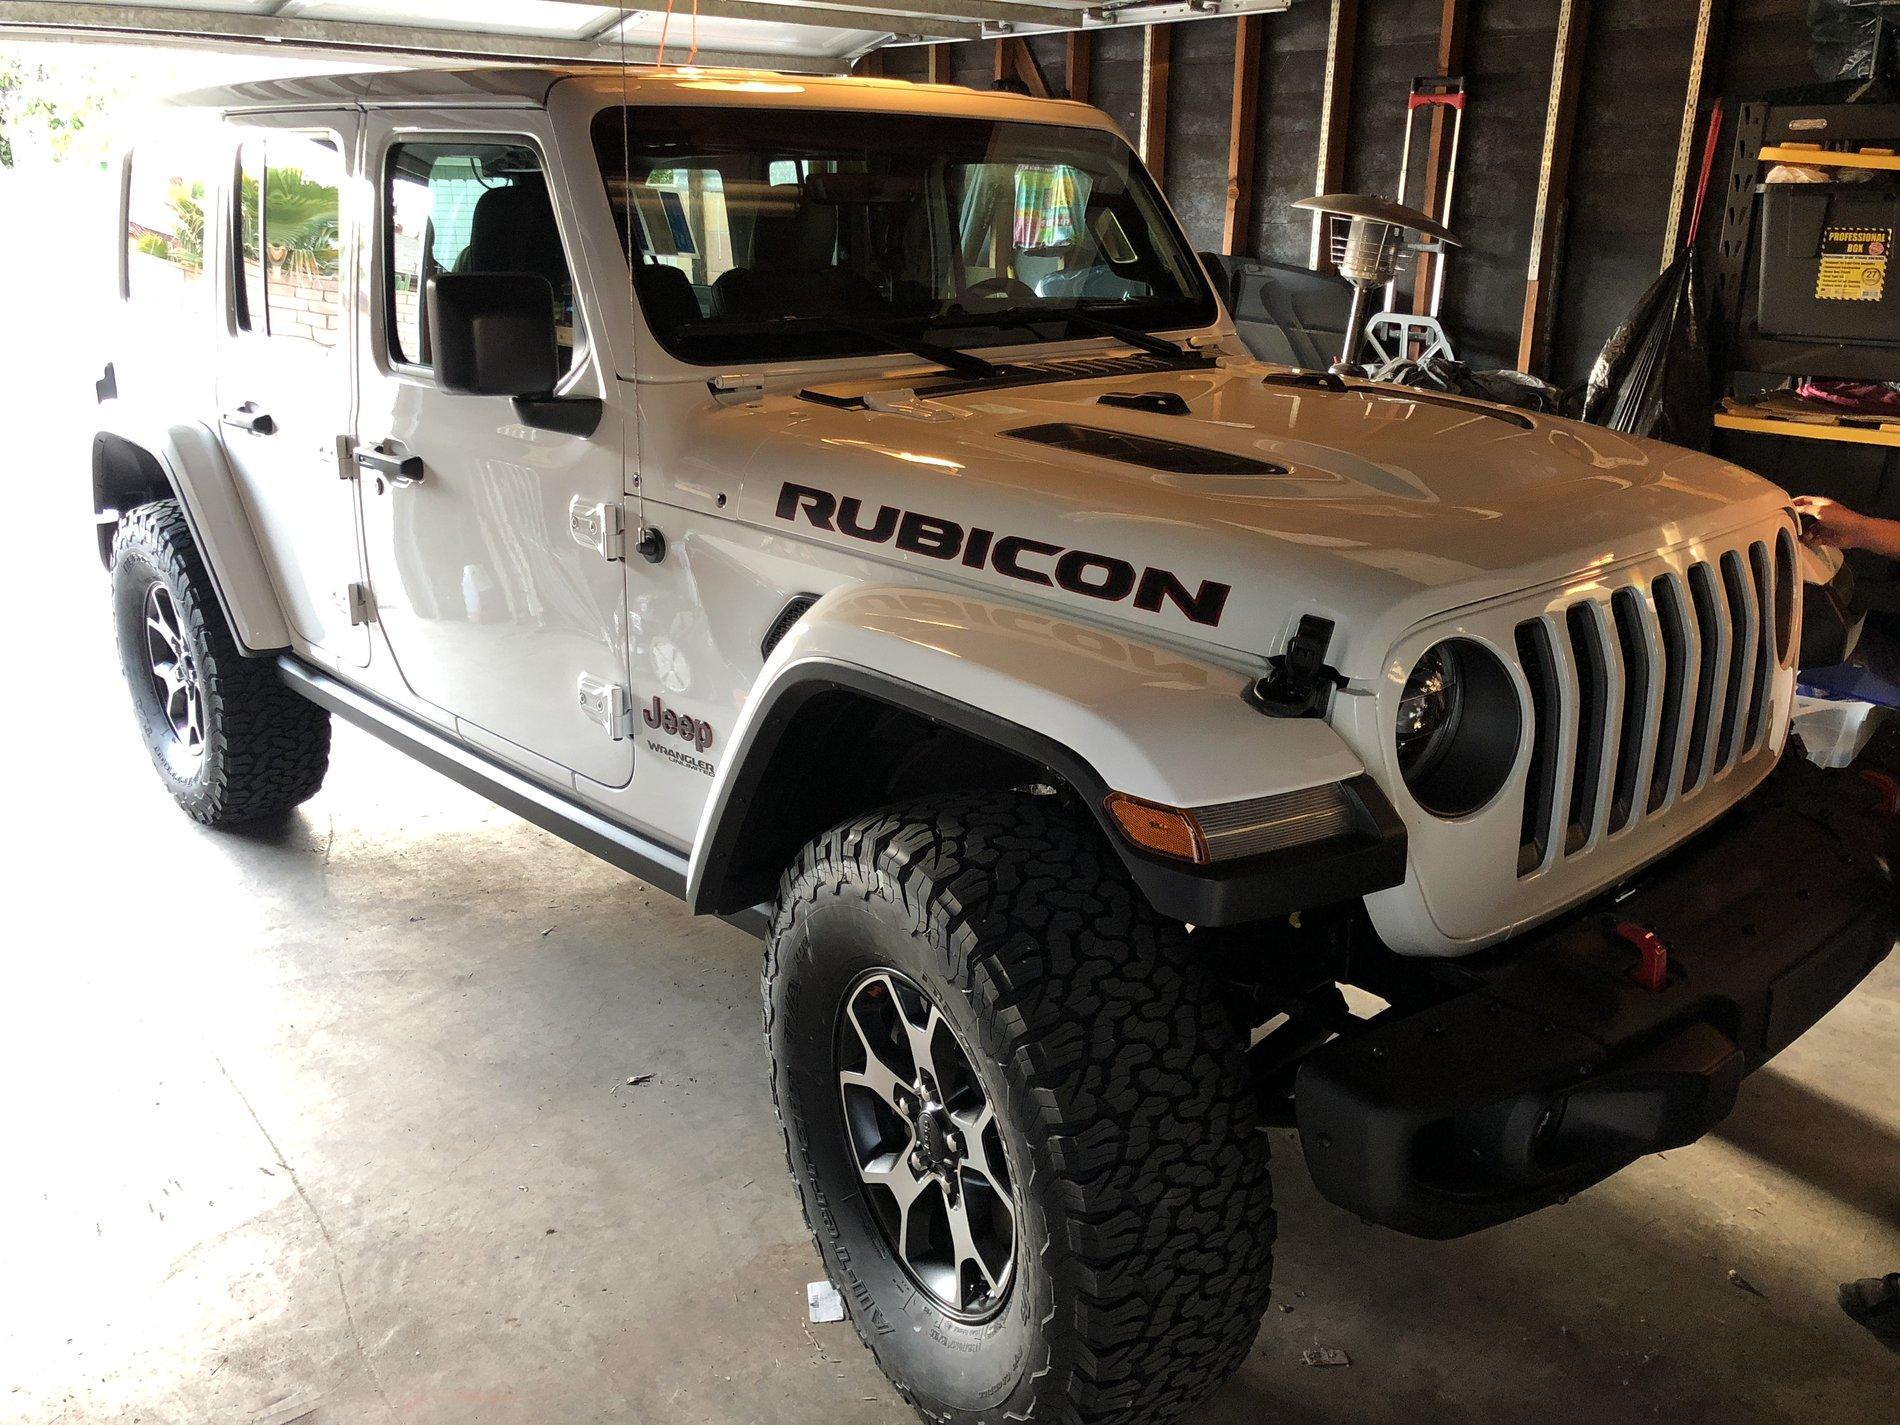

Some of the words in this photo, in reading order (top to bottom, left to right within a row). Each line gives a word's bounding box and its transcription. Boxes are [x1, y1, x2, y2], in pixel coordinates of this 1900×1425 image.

[1828, 232, 1886, 242] PROFESSIONAL
[1866, 270, 1877, 279] 27
[775, 481, 1232, 627] RUBICON
[643, 695, 713, 753] Jeep
[647, 739, 716, 774] WRANGLER
[668, 756, 716, 778] UNLIMITED
